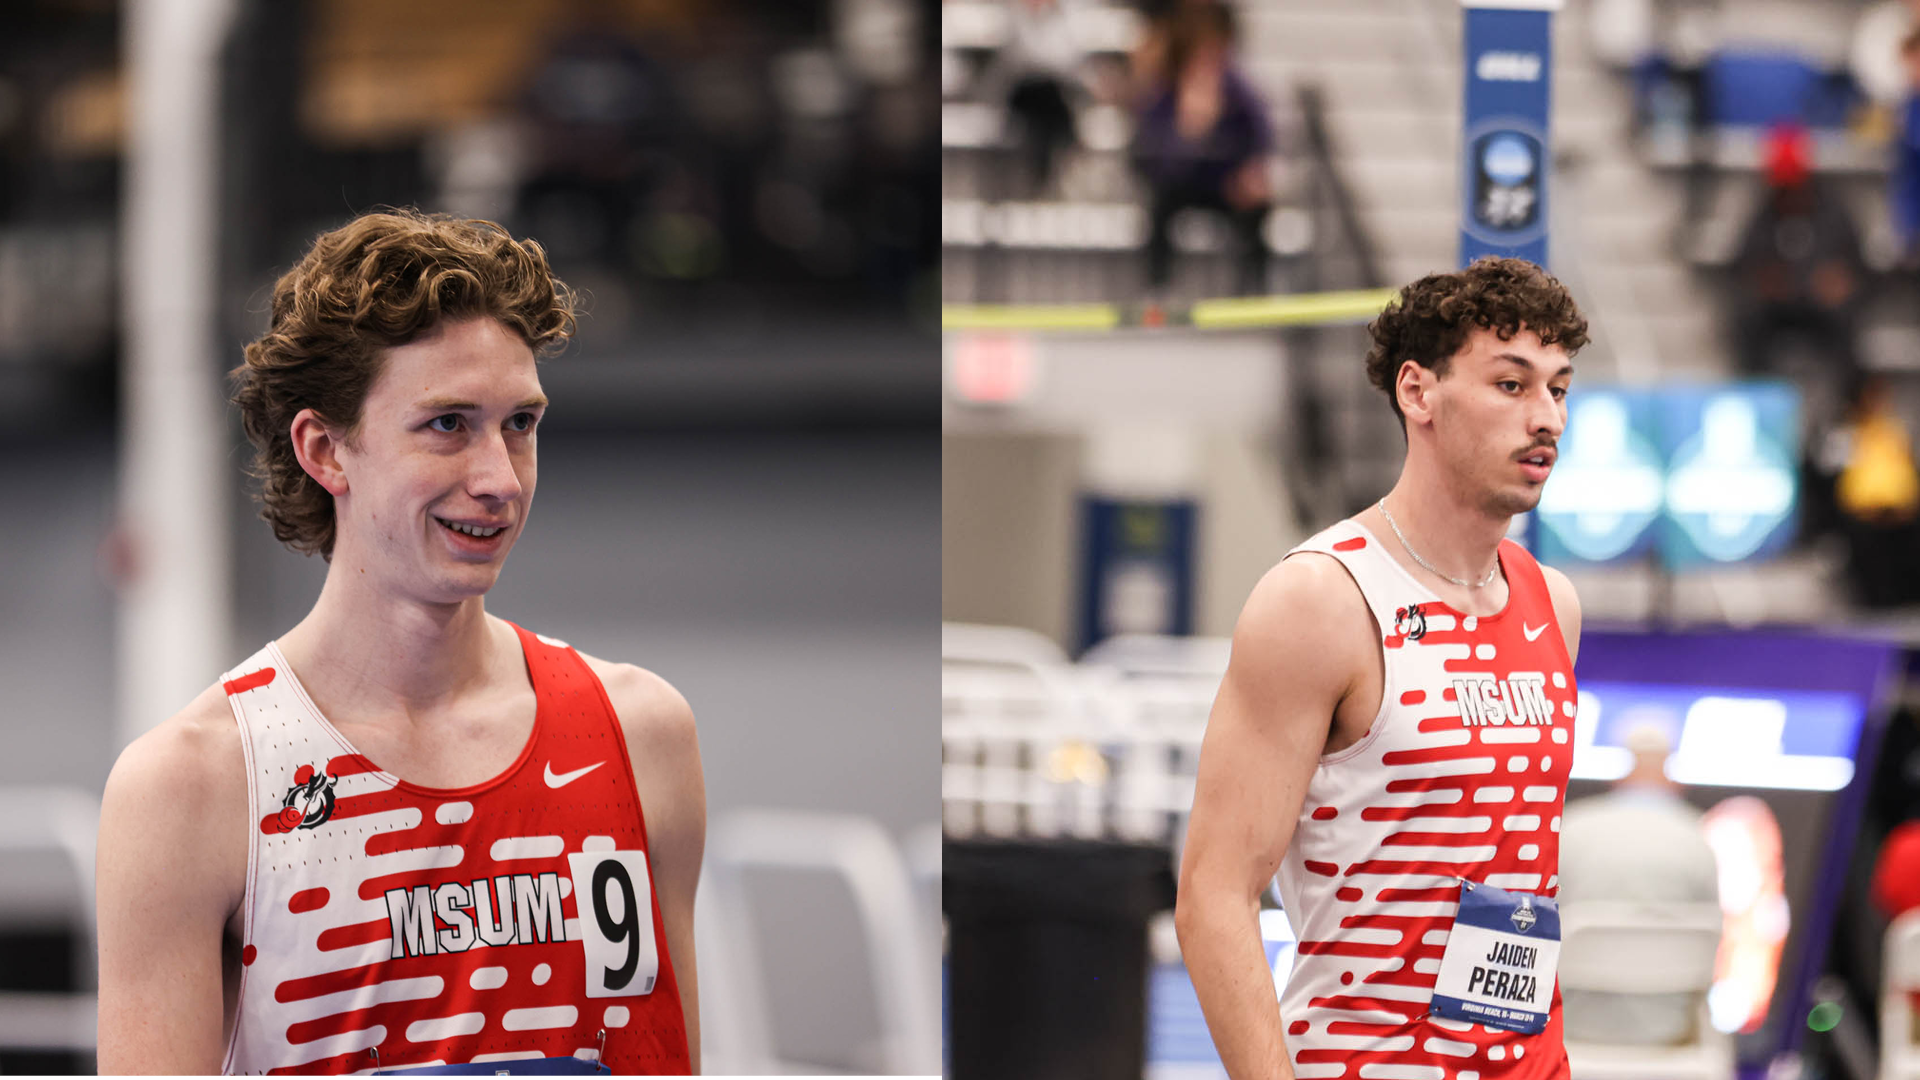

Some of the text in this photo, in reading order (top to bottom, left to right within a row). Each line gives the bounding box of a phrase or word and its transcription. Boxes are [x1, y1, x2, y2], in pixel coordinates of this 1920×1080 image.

[1452, 679, 1553, 726] MSUM
[385, 872, 566, 959] MSUM
[591, 858, 640, 991] 9
[1486, 941, 1538, 970] JAIDEN
[1467, 966, 1537, 1004] PERAZA
